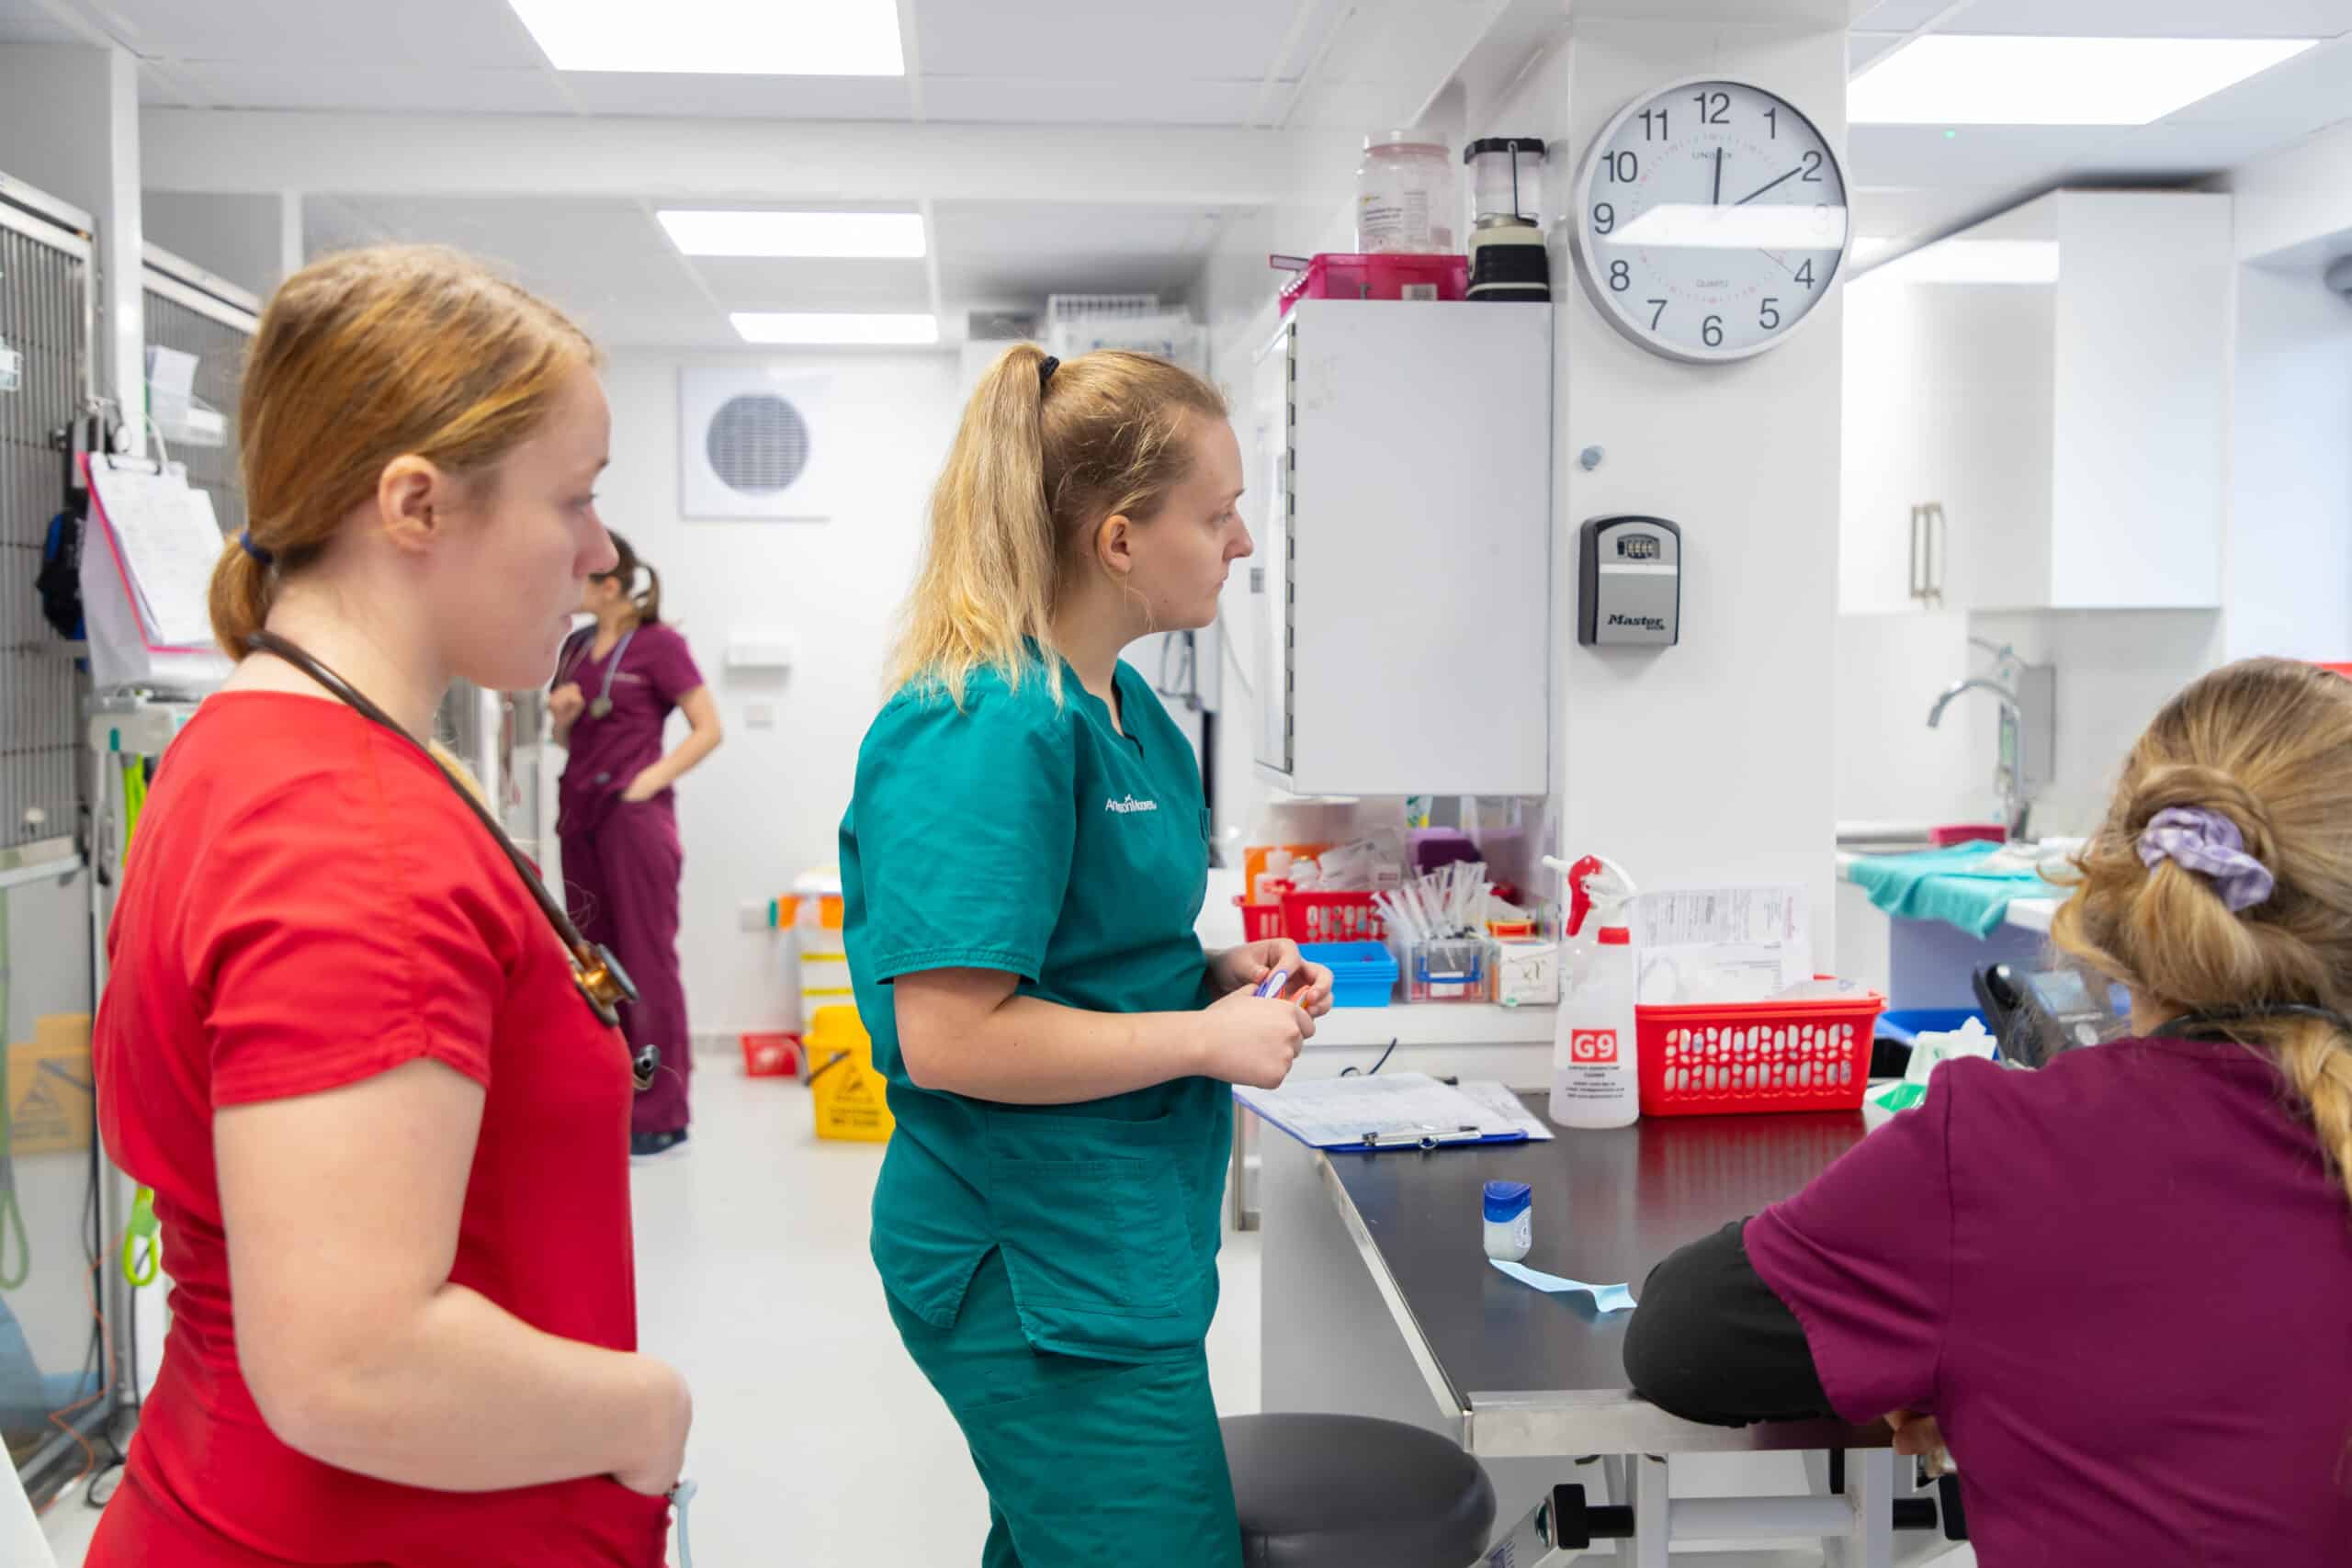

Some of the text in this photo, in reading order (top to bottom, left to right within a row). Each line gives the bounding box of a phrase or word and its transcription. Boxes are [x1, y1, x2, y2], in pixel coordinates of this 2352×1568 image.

[1693, 92, 1730, 124] 12
[1763, 107, 1777, 140] 1
[1638, 108, 1668, 141] 11
[1602, 151, 1638, 183] 10
[1801, 150, 1823, 182] 2
[1593, 203, 1615, 234] 9
[1610, 260, 1630, 291] 8
[1794, 258, 1815, 289] 4
[1646, 299, 1668, 331] 7
[1759, 298, 1780, 330] 5
[1702, 315, 1723, 346] 6
[1608, 614, 1663, 626] Master
[1574, 1033, 1615, 1059] G9
